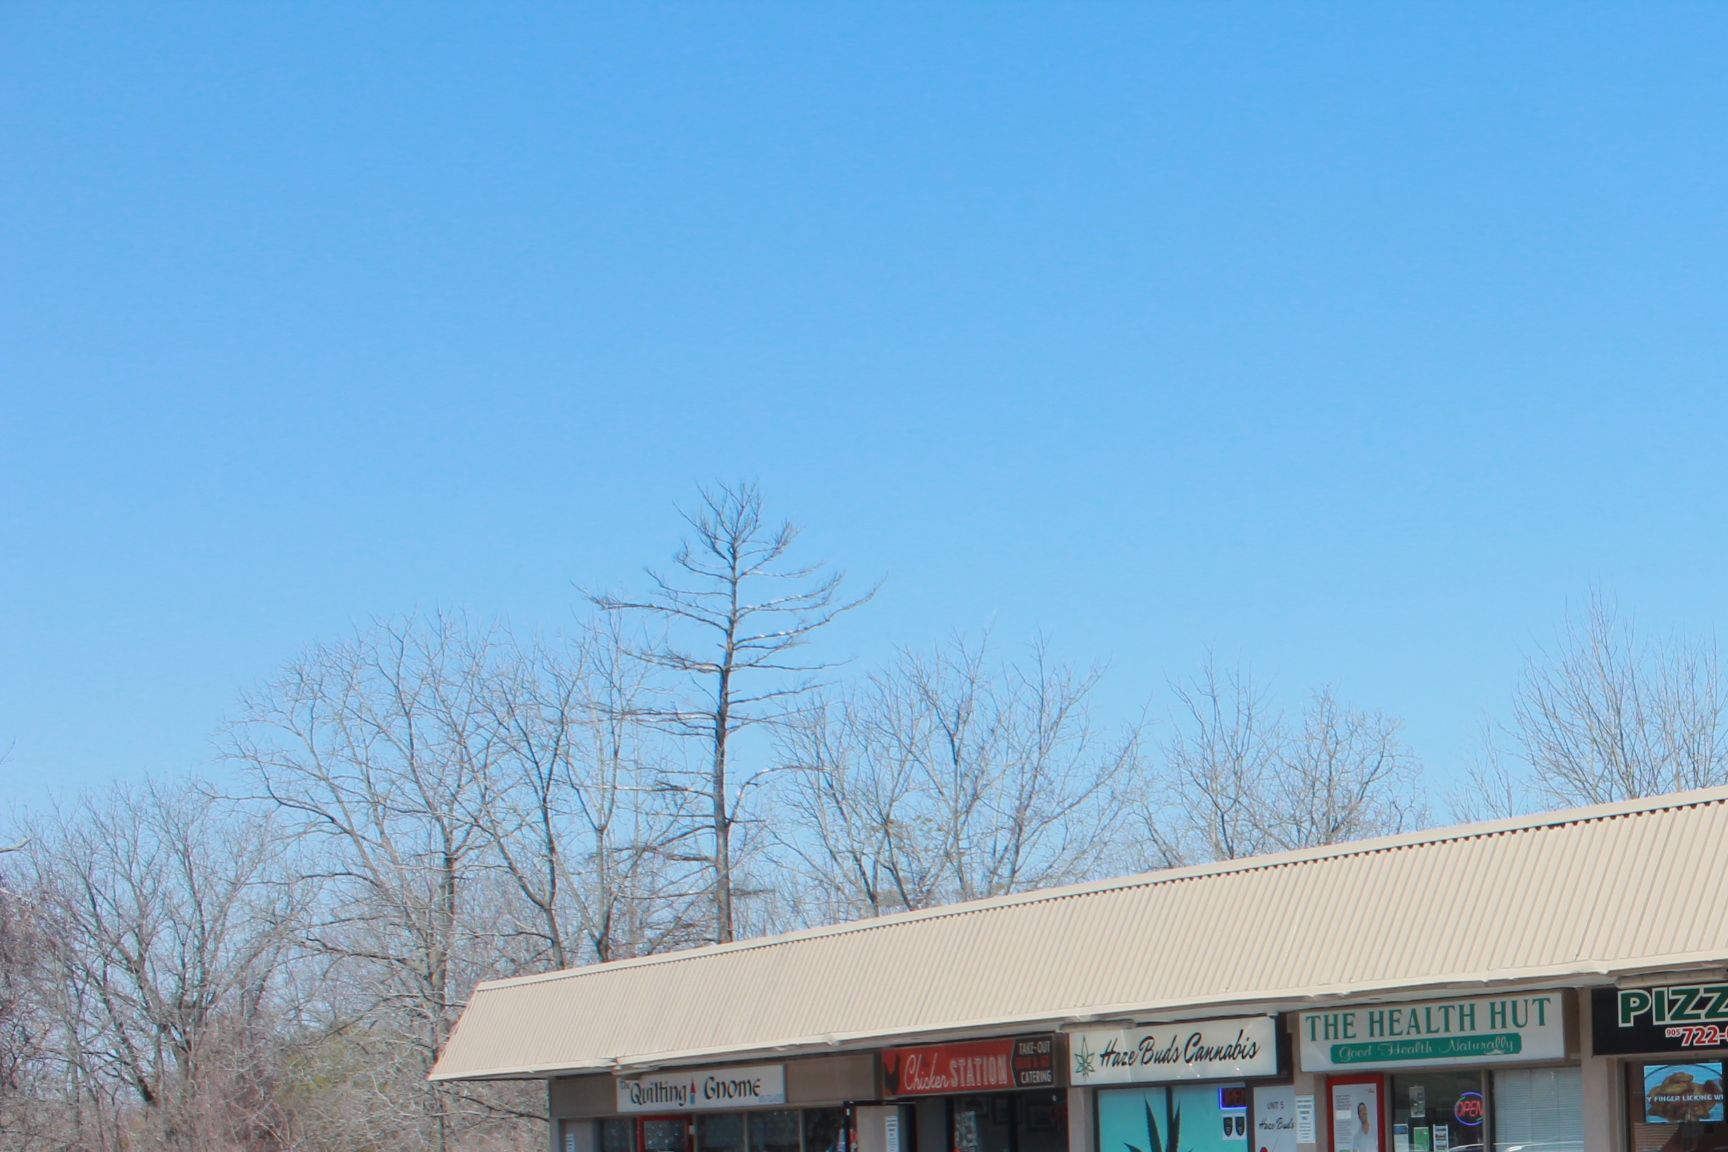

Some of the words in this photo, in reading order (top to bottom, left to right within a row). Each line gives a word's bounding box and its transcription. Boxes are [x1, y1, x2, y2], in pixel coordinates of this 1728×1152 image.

[1305, 1012, 1356, 1041] THE
[1368, 1003, 1476, 1037] HEALTH
[1489, 998, 1551, 1029] HUT
[1665, 1027, 1681, 1038] 905
[1018, 1041, 1050, 1055] TAKE-OUT
[1100, 1038, 1136, 1068] Haze
[1138, 1034, 1182, 1065] Buds
[1183, 1029, 1260, 1063] Cannabis
[1338, 1046, 1372, 1063] Good
[1380, 1041, 1433, 1057] Health
[1438, 1035, 1514, 1054] Naturally
[904, 1053, 949, 1090] Chicken
[950, 1055, 1008, 1087] STATION
[1021, 1070, 1052, 1084] CATERING
[630, 1081, 687, 1106] Quilting
[704, 1076, 761, 1100] Gnome
[1654, 1095, 1681, 1103] FINGER
[1682, 1094, 1713, 1102] LICKING
[1456, 1099, 1487, 1117] OPEN
[1276, 1117, 1295, 1130] Buds
